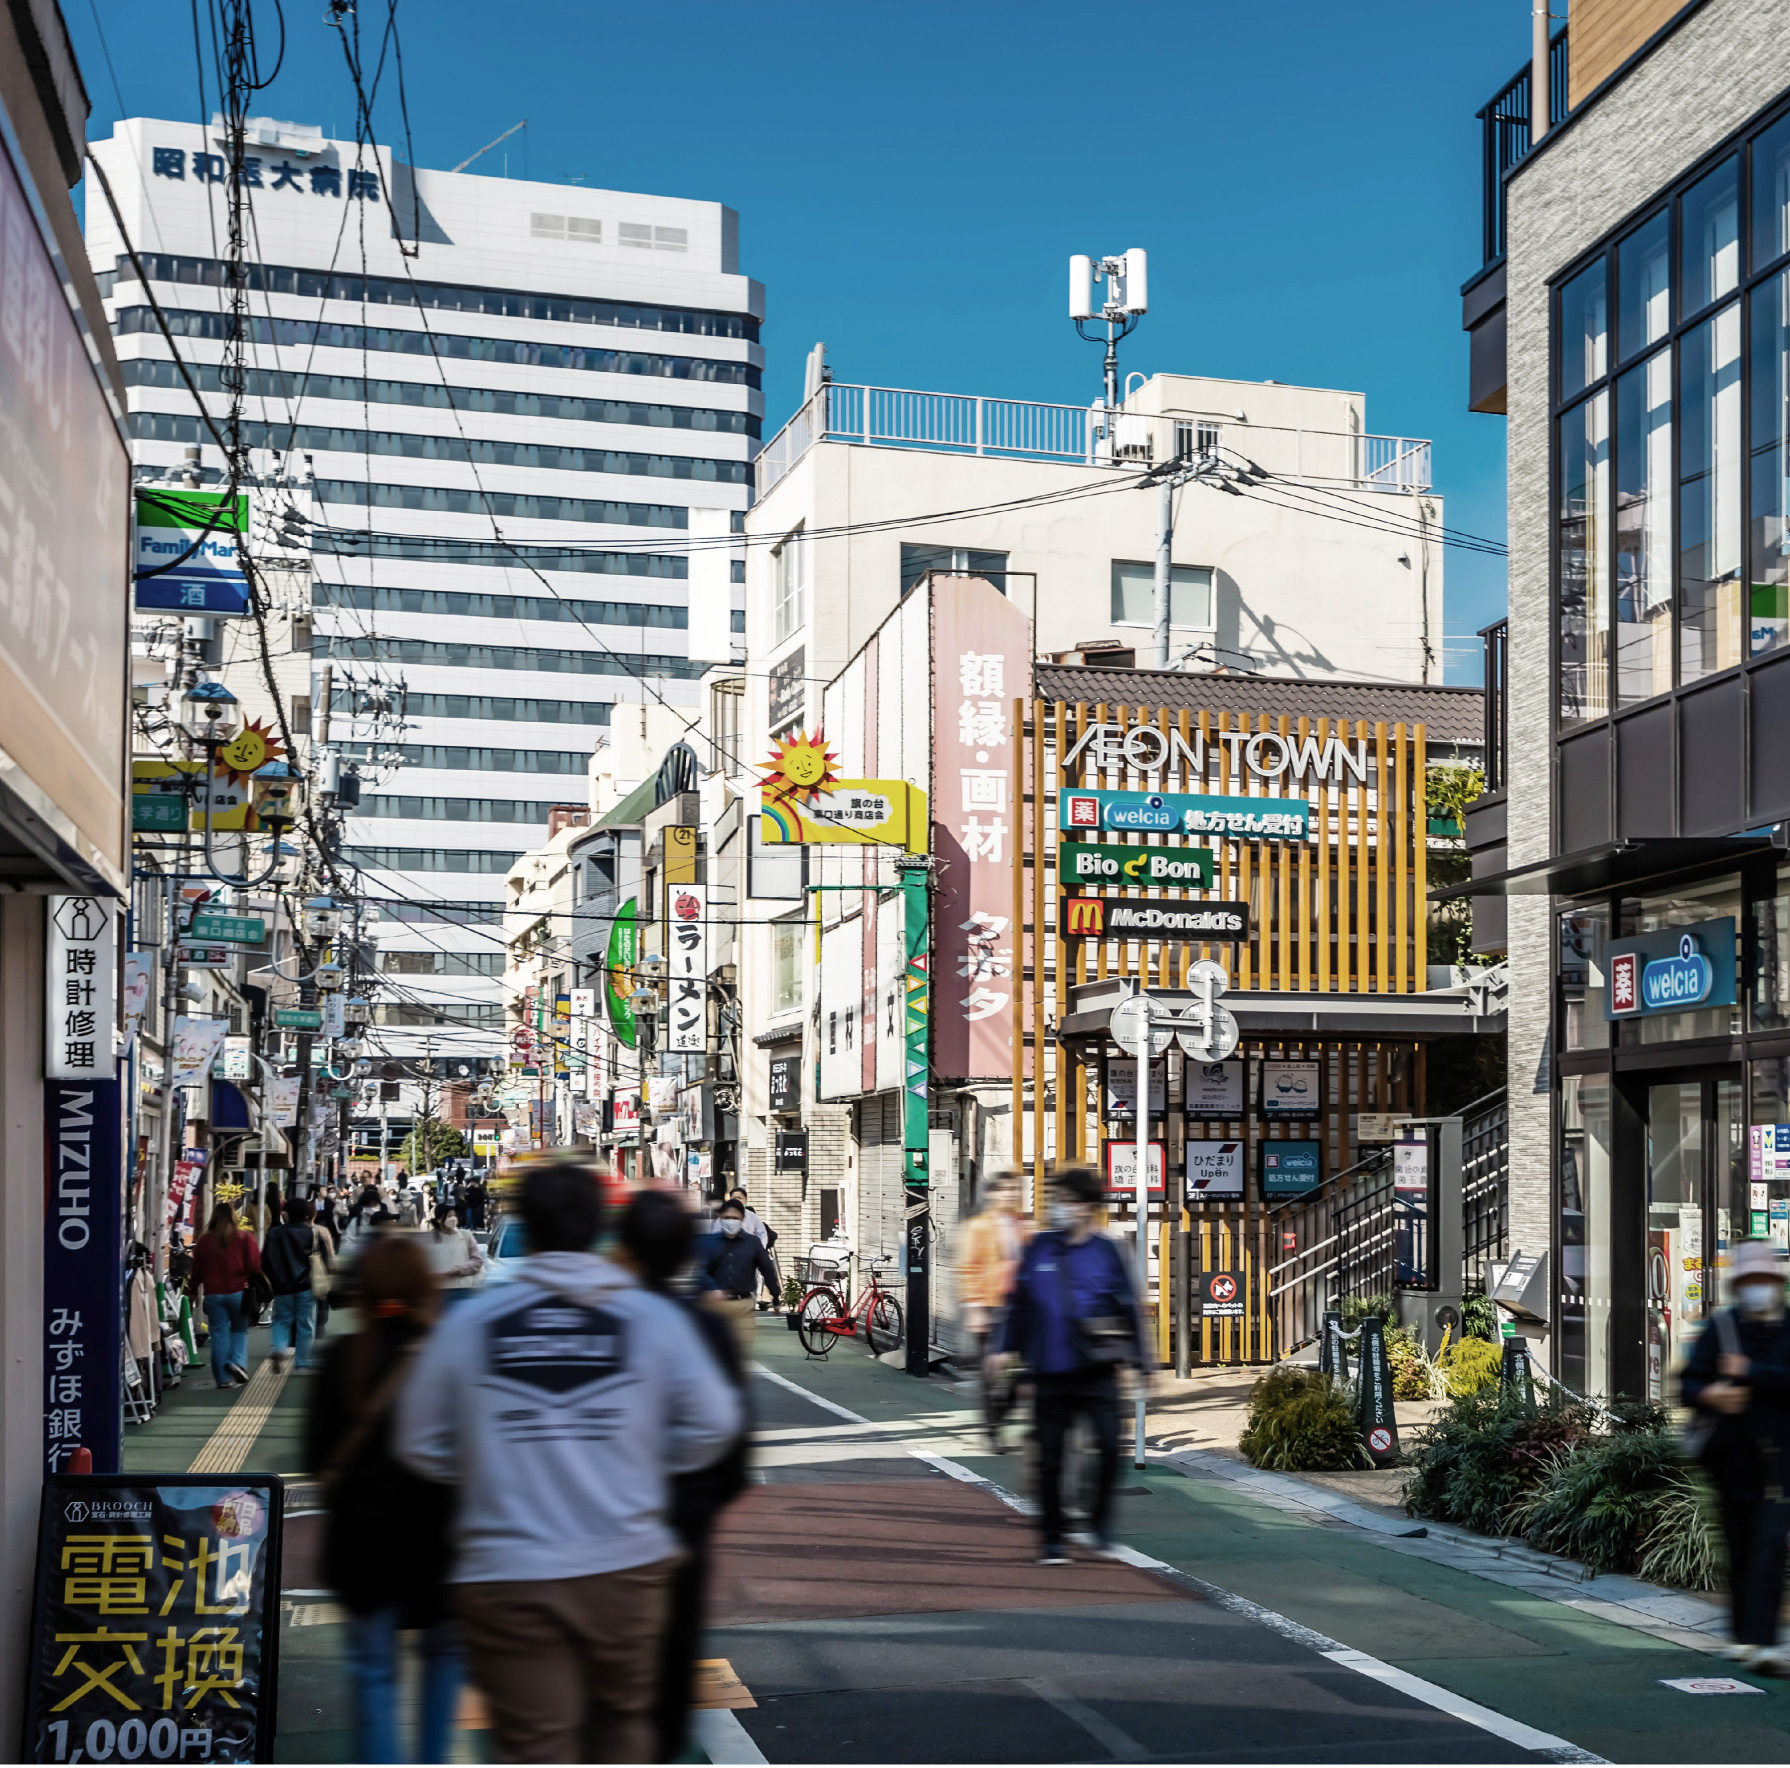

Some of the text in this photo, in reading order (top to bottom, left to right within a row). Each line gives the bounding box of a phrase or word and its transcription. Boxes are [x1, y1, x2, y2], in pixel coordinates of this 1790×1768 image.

[152, 146, 380, 203] 昭和医大病院
[140, 536, 239, 560] FamilyMar
[180, 583, 206, 606] 酒
[957, 651, 1009, 863] 額縁・画材
[1218, 732, 1367, 782] TOWN
[813, 809, 885, 820] 東口通り商店会
[850, 798, 885, 809] 旗の台
[1074, 800, 1305, 836] 薬 welcia 処方せん受付
[679, 829, 691, 840] 21
[1076, 852, 1119, 876] Bio
[1150, 855, 1201, 879] Bon
[1110, 907, 1243, 932] McDonald's
[674, 925, 703, 1032] ラーメン
[1614, 963, 1700, 1004] 薬 welcia
[65, 948, 97, 1069] 時計修理
[58, 1089, 95, 1251] MIZUHO
[1114, 1164, 1159, 1174] 旗の科
[1193, 1155, 1235, 1167] ひだまり
[1268, 1173, 1315, 1183] 処方せん受付
[48, 1307, 85, 1474] みずほ銀行
[91, 1501, 153, 1511] BROOCH
[60, 1534, 251, 1616] 電池
[49, 1626, 247, 1712] 交換
